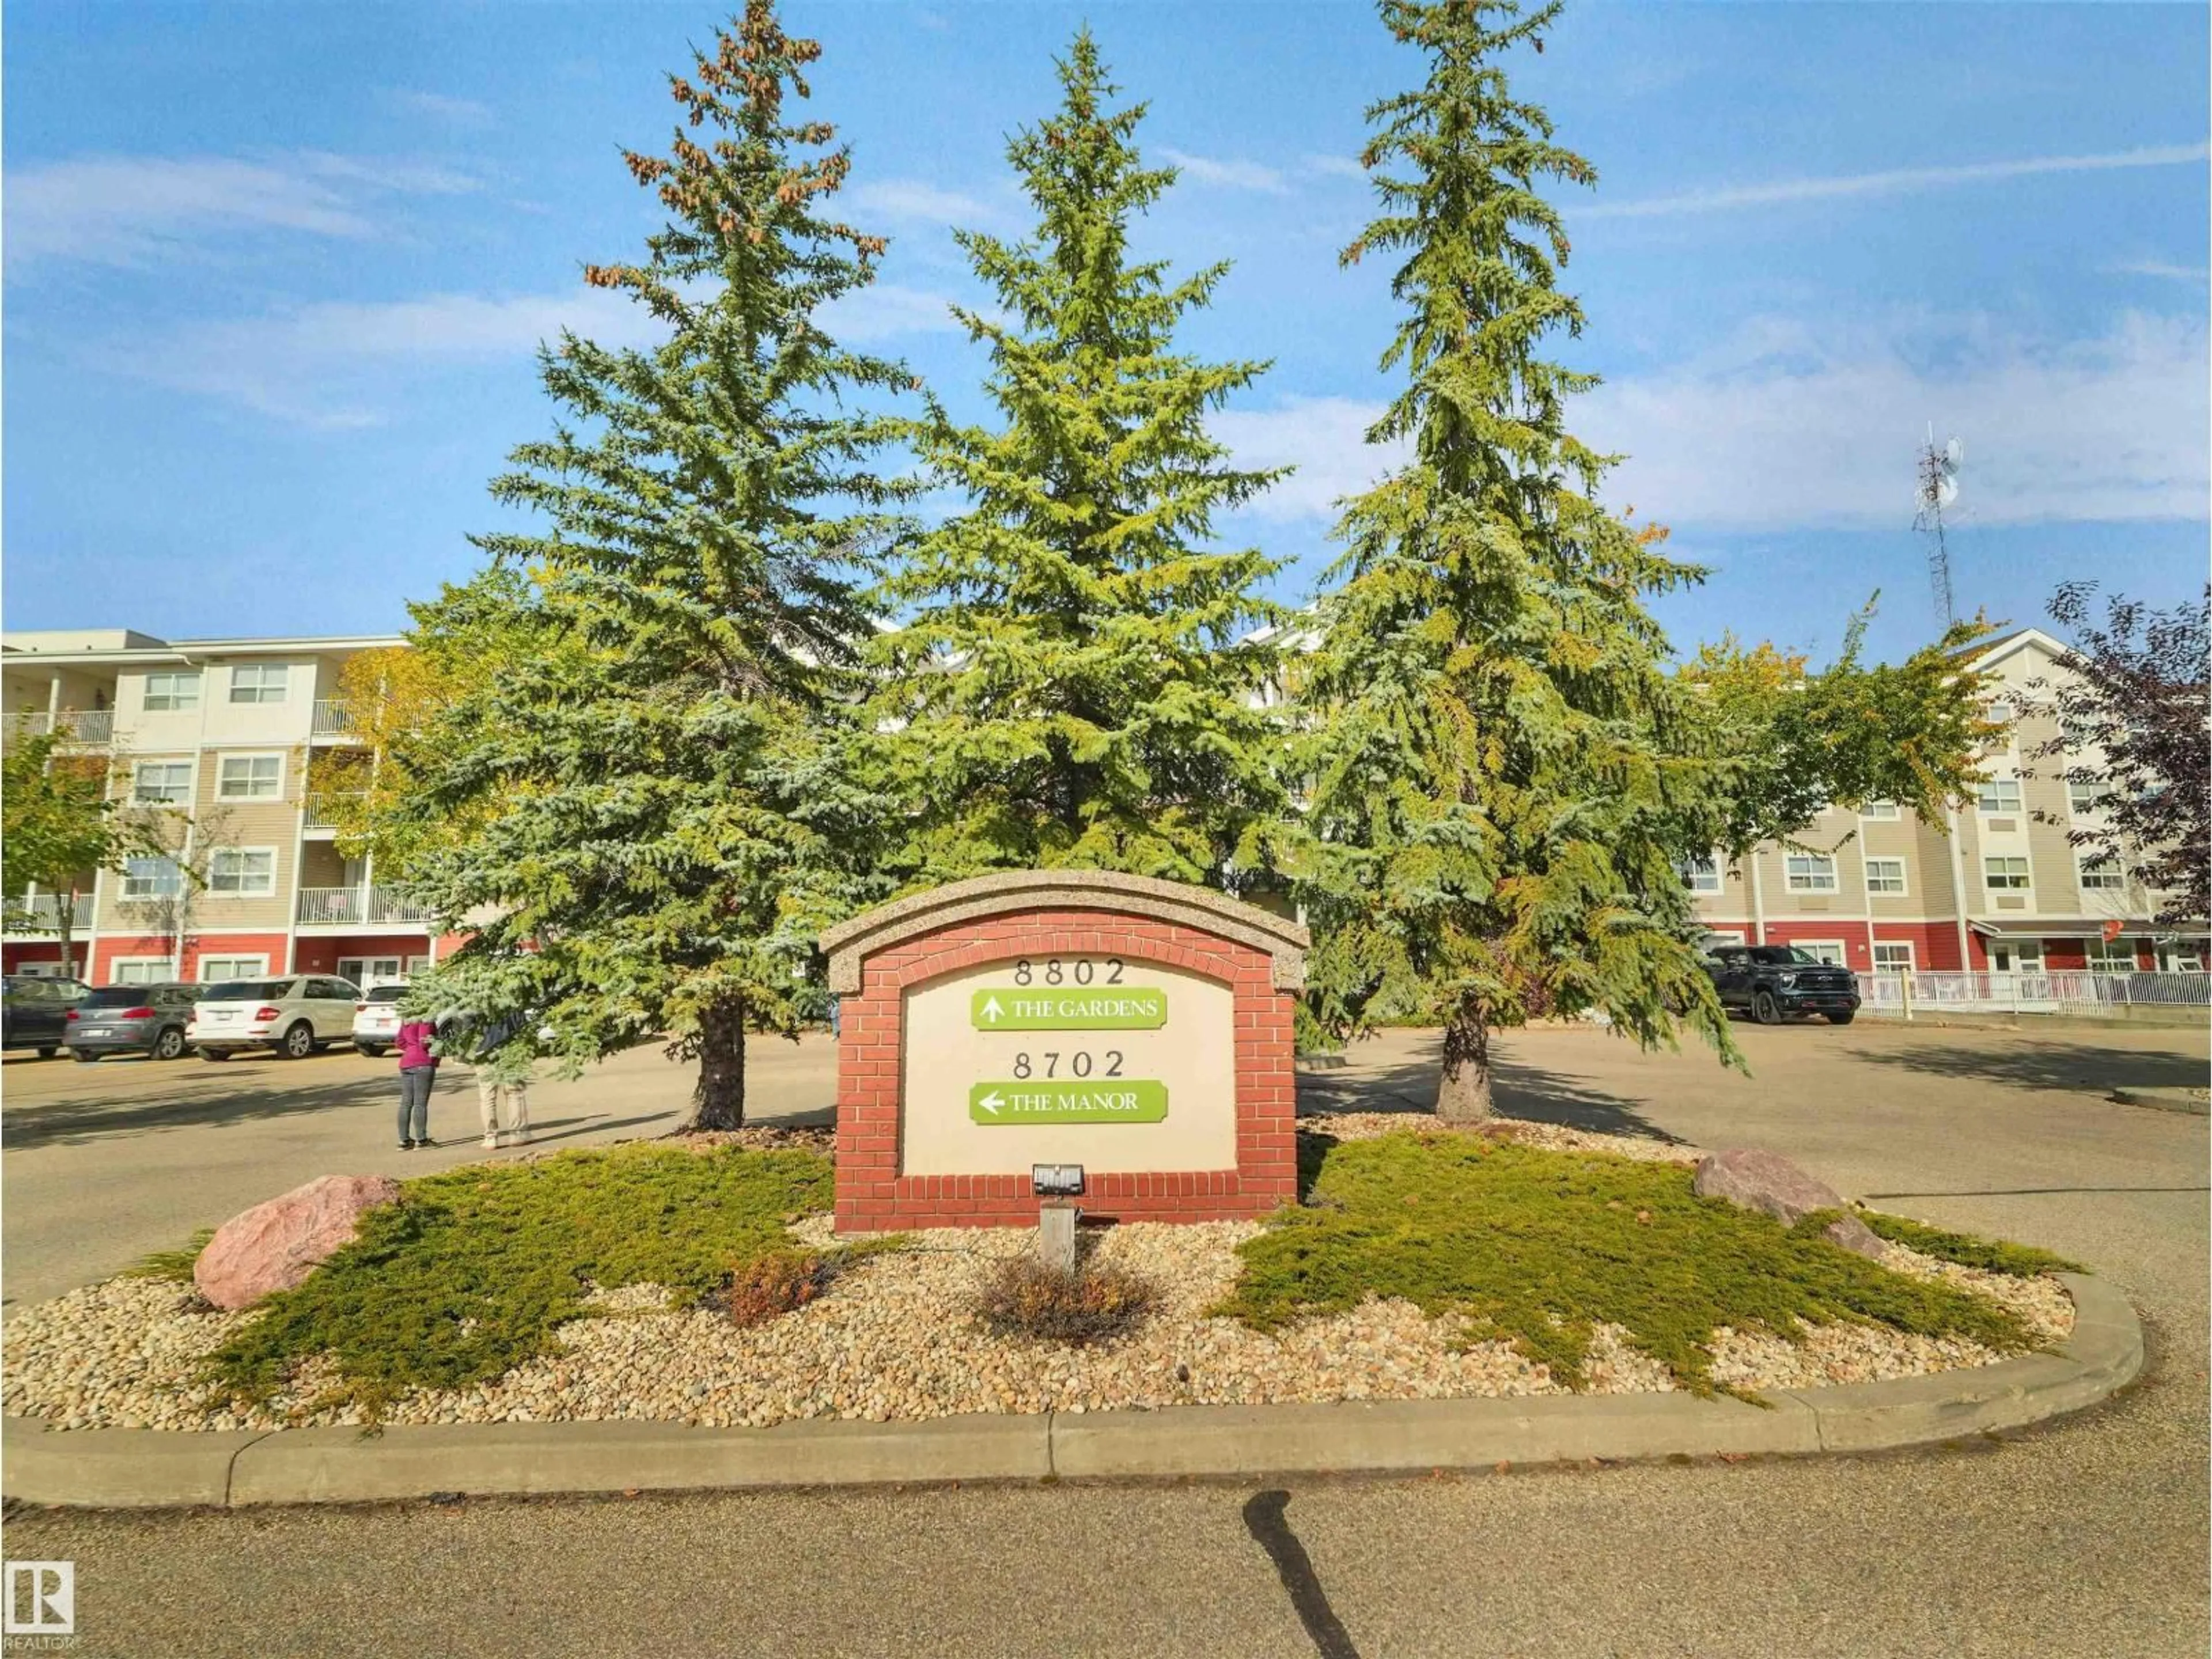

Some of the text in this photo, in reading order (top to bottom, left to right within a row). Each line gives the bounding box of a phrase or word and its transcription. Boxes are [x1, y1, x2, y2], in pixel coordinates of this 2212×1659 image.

[1014, 959, 1123, 986] 8802
[1012, 999, 1158, 1018] THE GARDENS
[1013, 1051, 1123, 1079] 8702
[1010, 1093, 1139, 1111] THE MANOR
